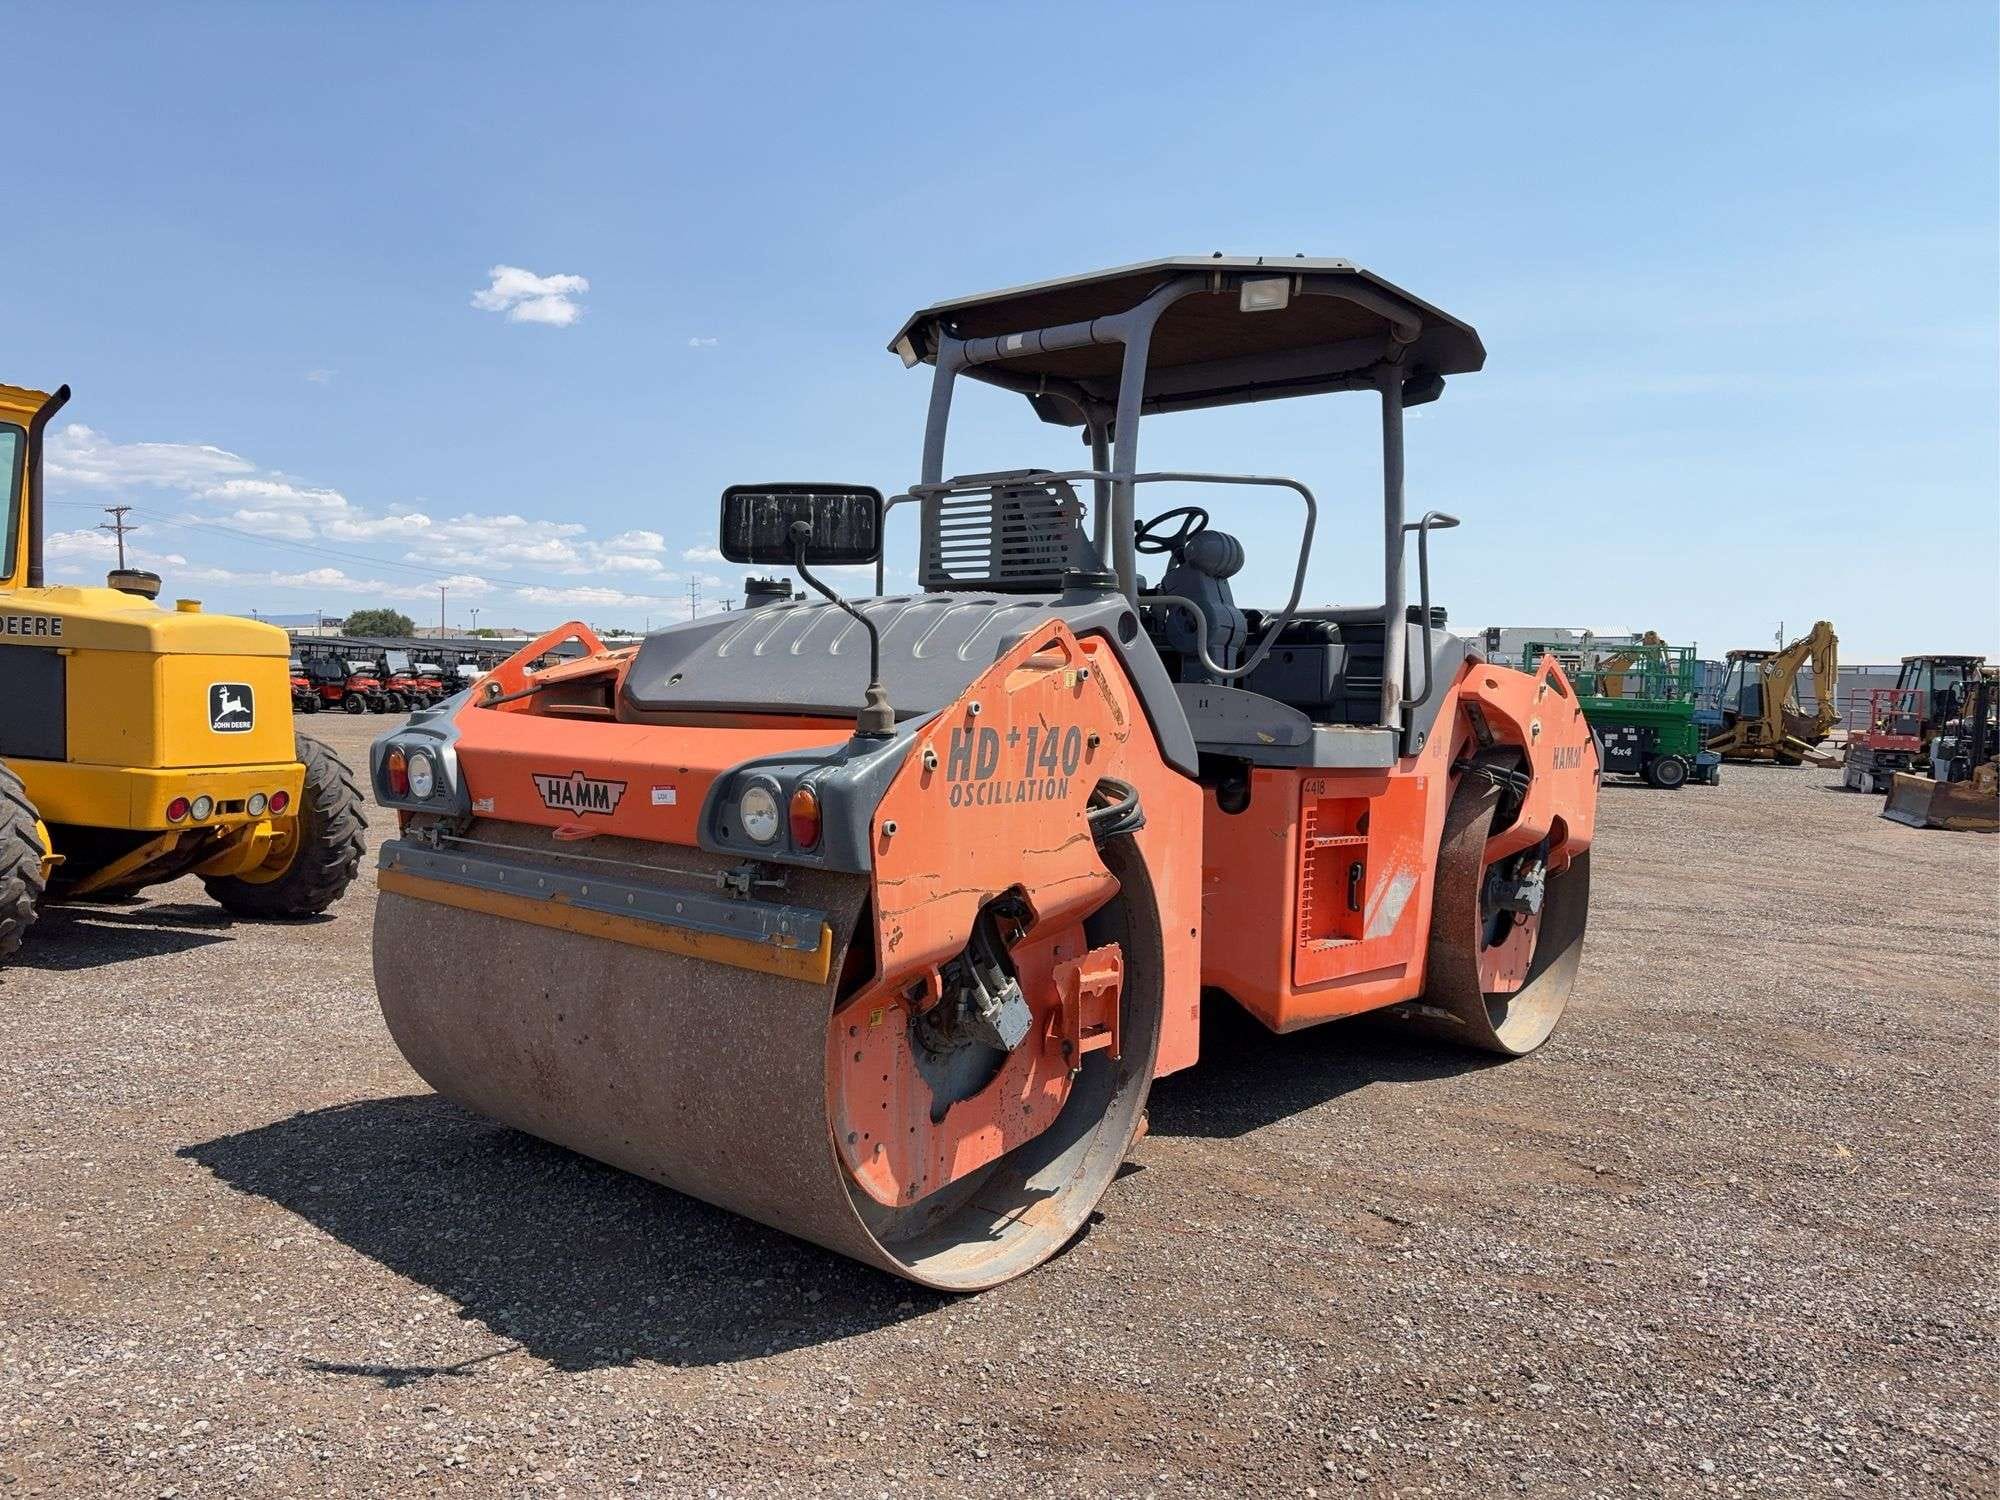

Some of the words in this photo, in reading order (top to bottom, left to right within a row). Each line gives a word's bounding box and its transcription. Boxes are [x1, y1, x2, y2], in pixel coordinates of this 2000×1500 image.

[213, 721, 231, 729] JOHN
[231, 721, 251, 729] DEERE
[1553, 745, 1582, 770] HAMM
[1611, 746, 1632, 757] 4x4
[548, 779, 610, 810] HAMM
[949, 777, 1070, 808] OSCILLATION
[1304, 780, 1326, 796] 4418
